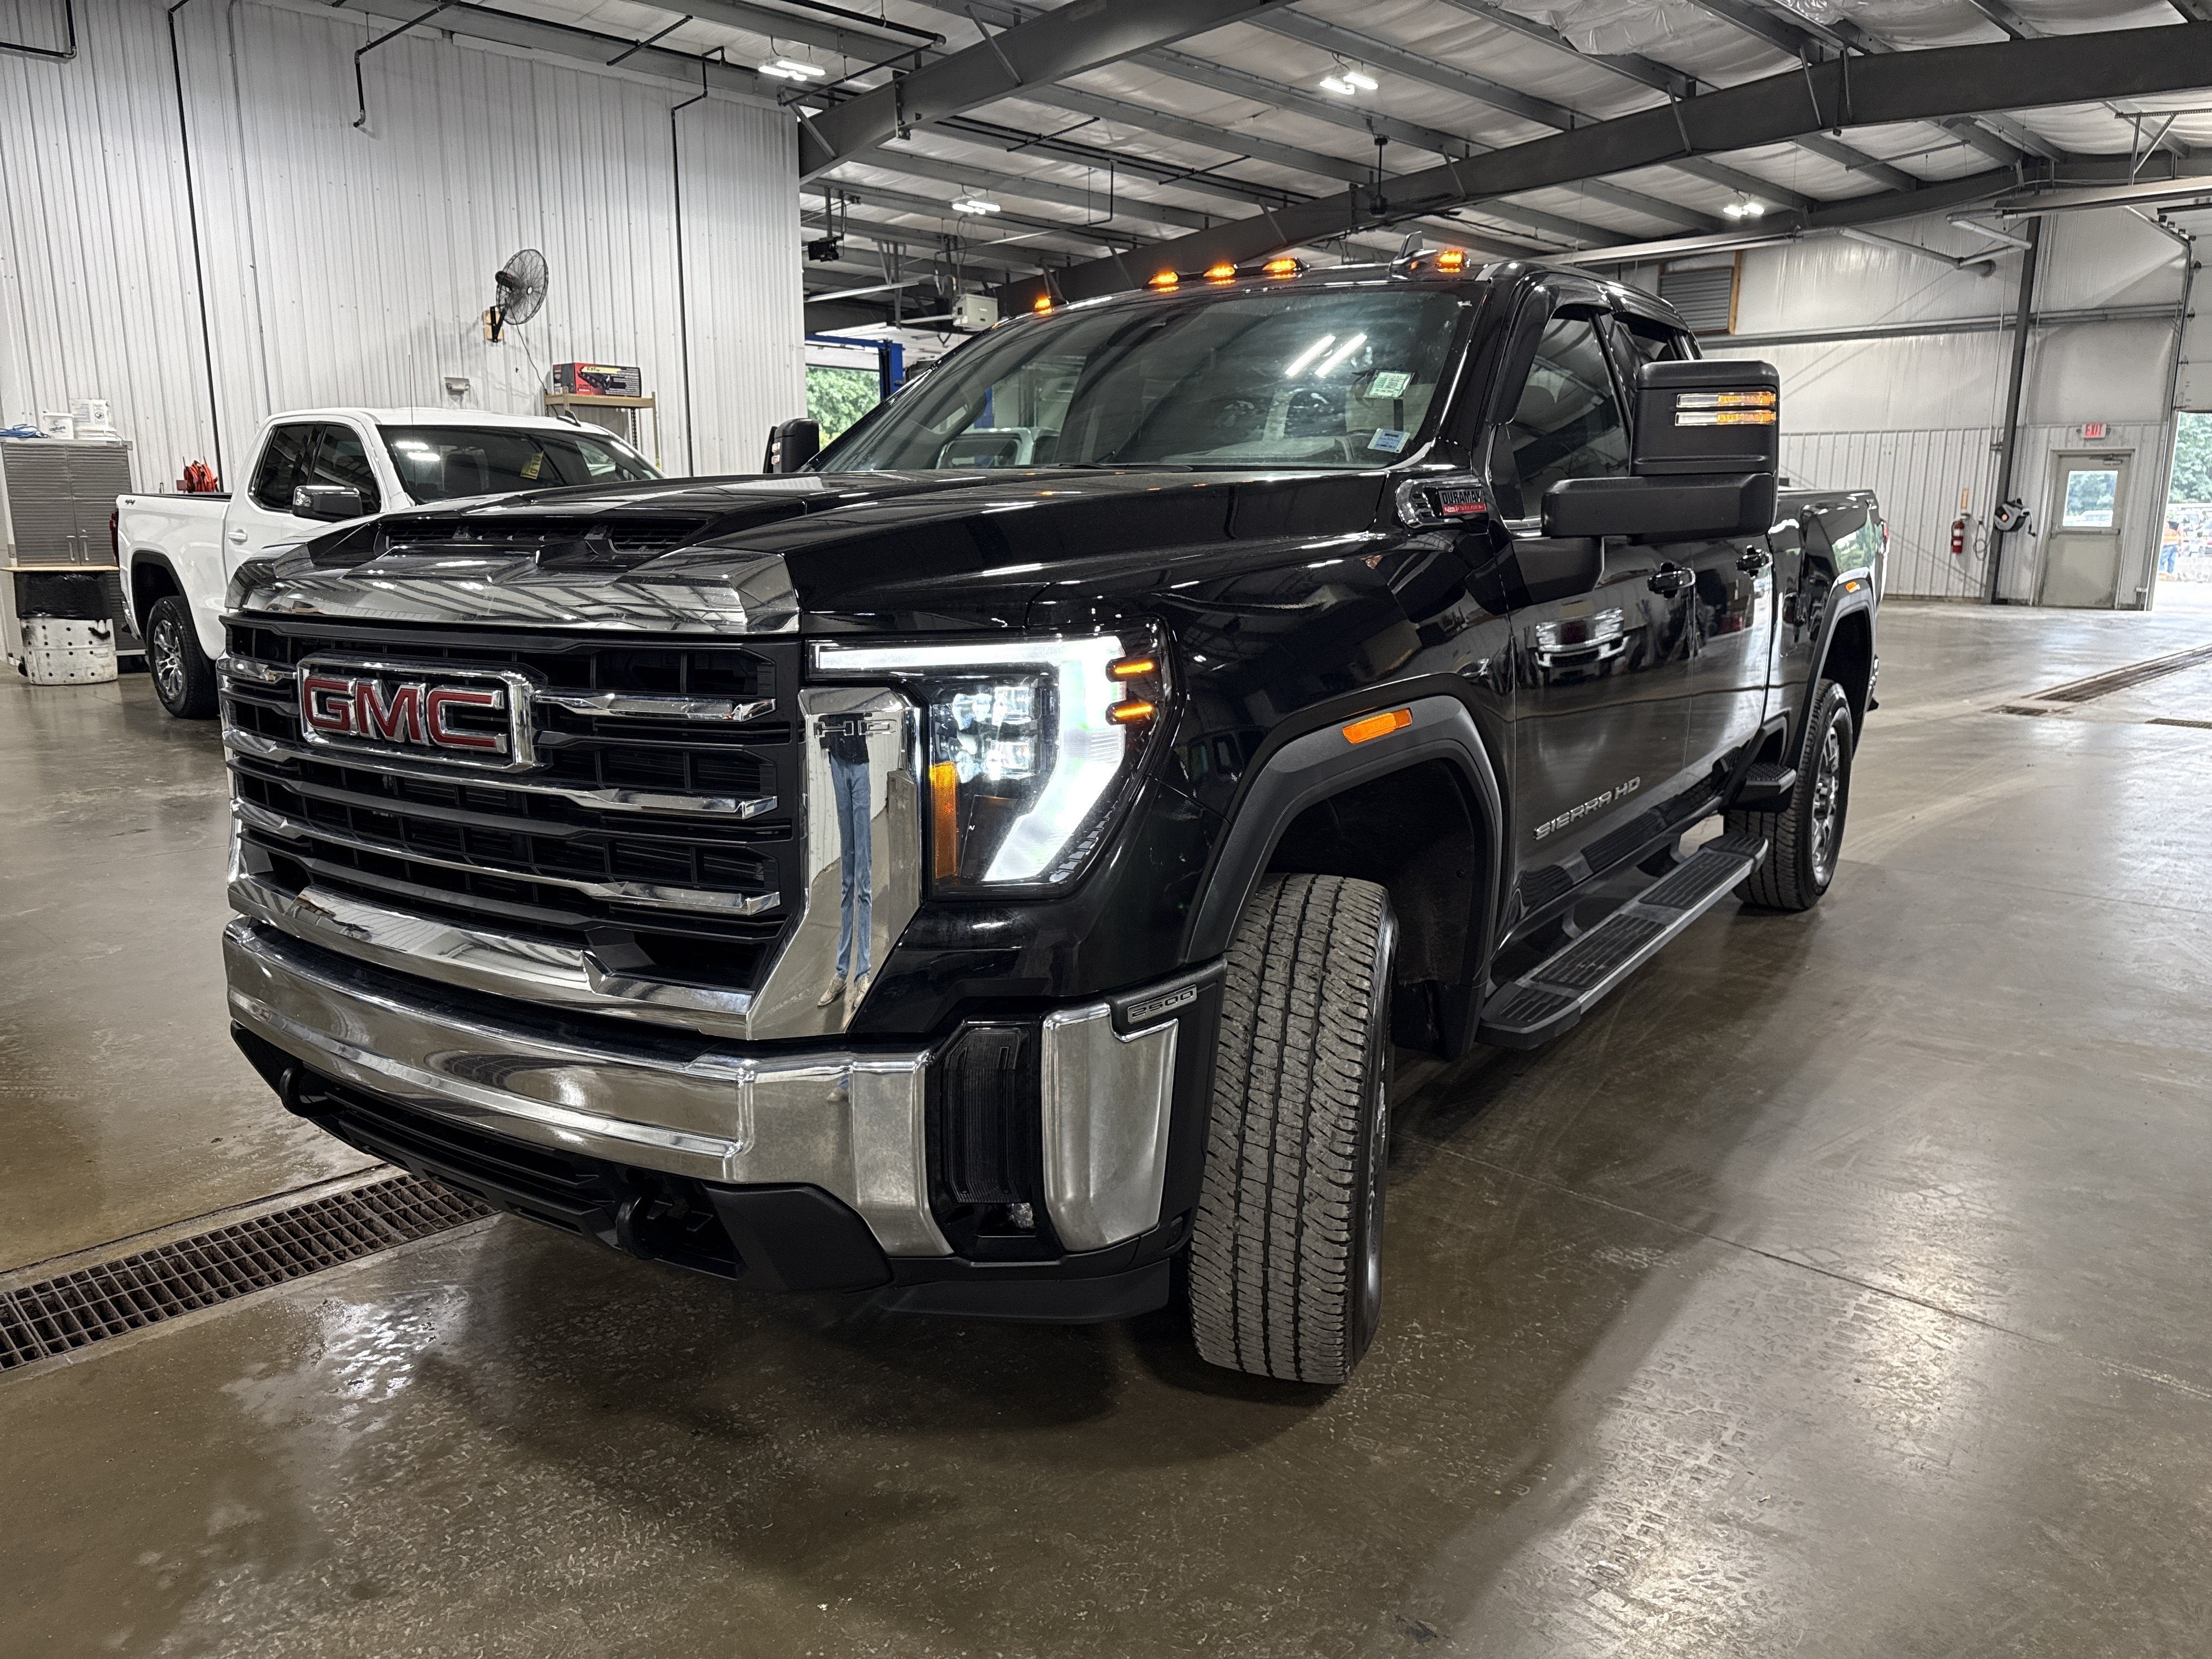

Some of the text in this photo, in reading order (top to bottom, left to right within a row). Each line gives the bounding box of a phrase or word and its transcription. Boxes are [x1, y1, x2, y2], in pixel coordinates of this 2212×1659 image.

[2085, 423, 2103, 437] EXIT
[303, 674, 507, 754] GMC
[1533, 777, 1640, 840] SIERRA HD
[1132, 990, 1193, 1018] 2500
